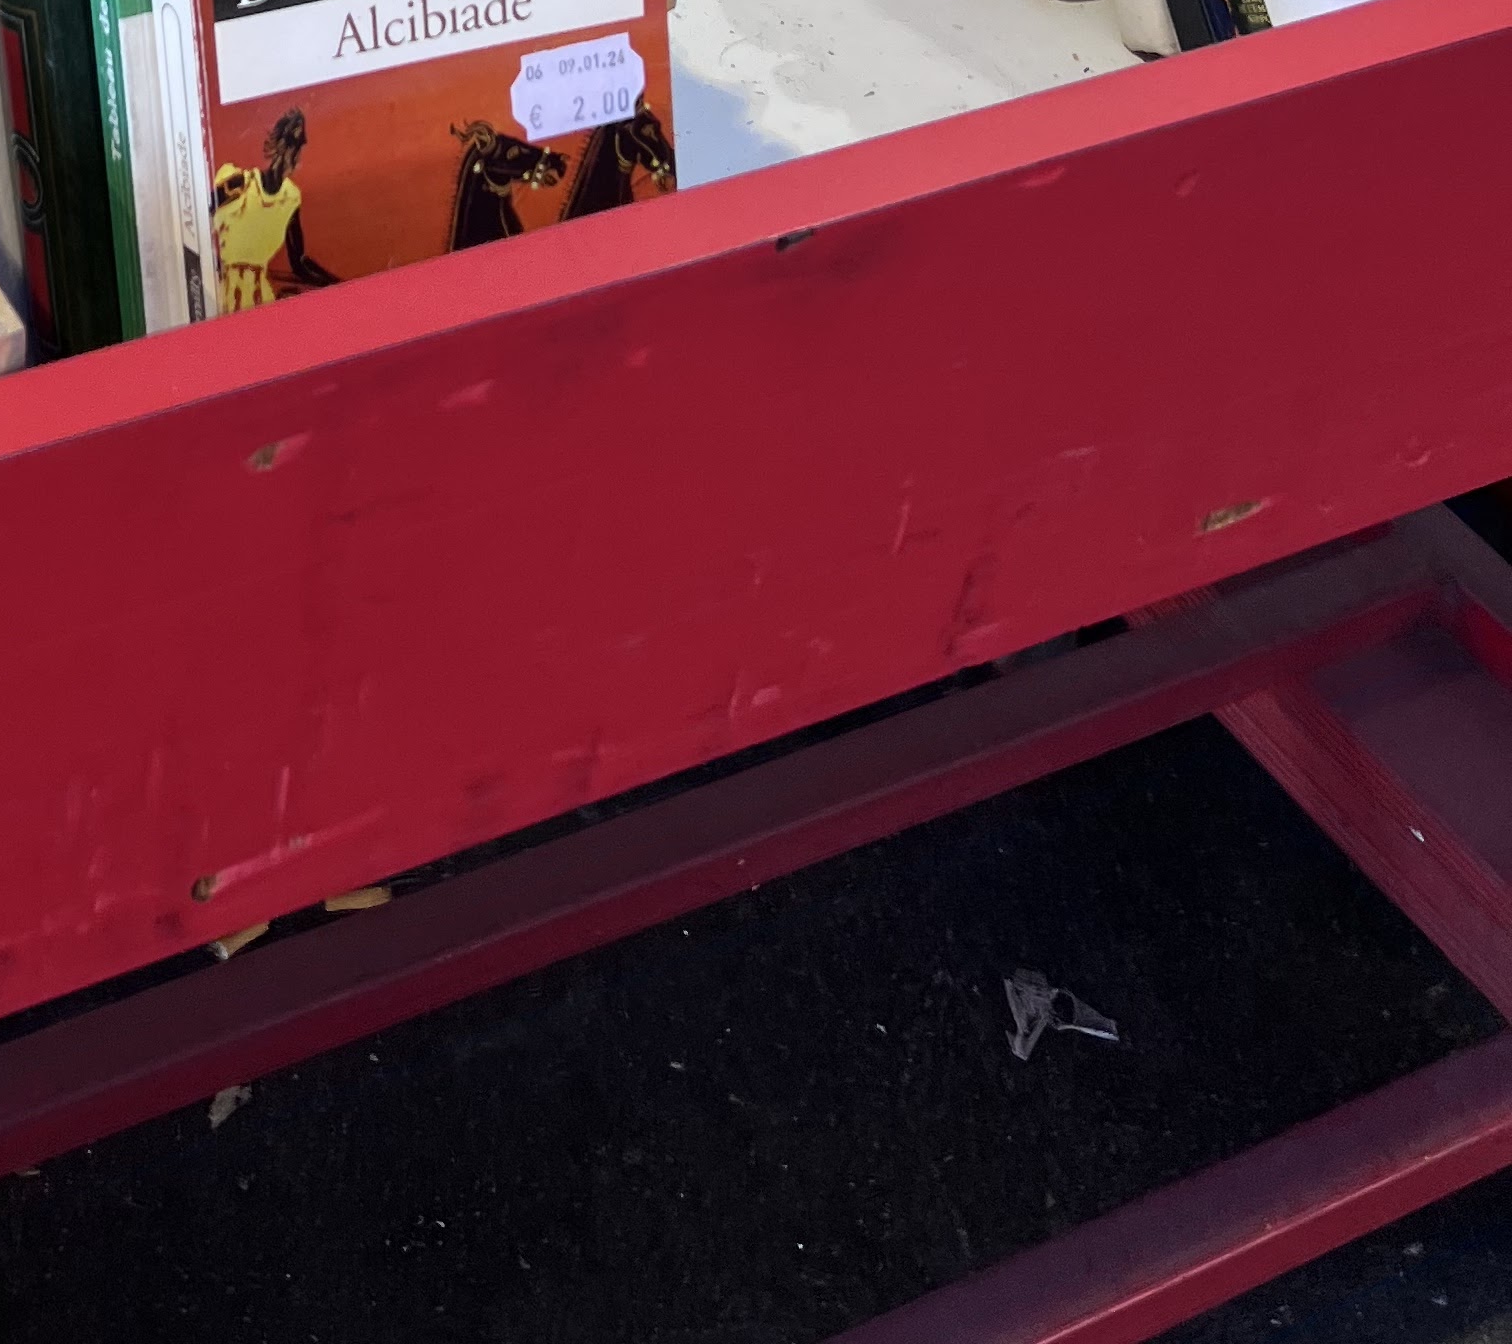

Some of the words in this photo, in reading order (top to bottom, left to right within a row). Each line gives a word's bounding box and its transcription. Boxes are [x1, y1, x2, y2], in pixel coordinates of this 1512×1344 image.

[525, 64, 543, 81] 06
[559, 49, 625, 75] 09.01.24
[530, 104, 543, 129] €
[573, 87, 630, 121] 2.00
